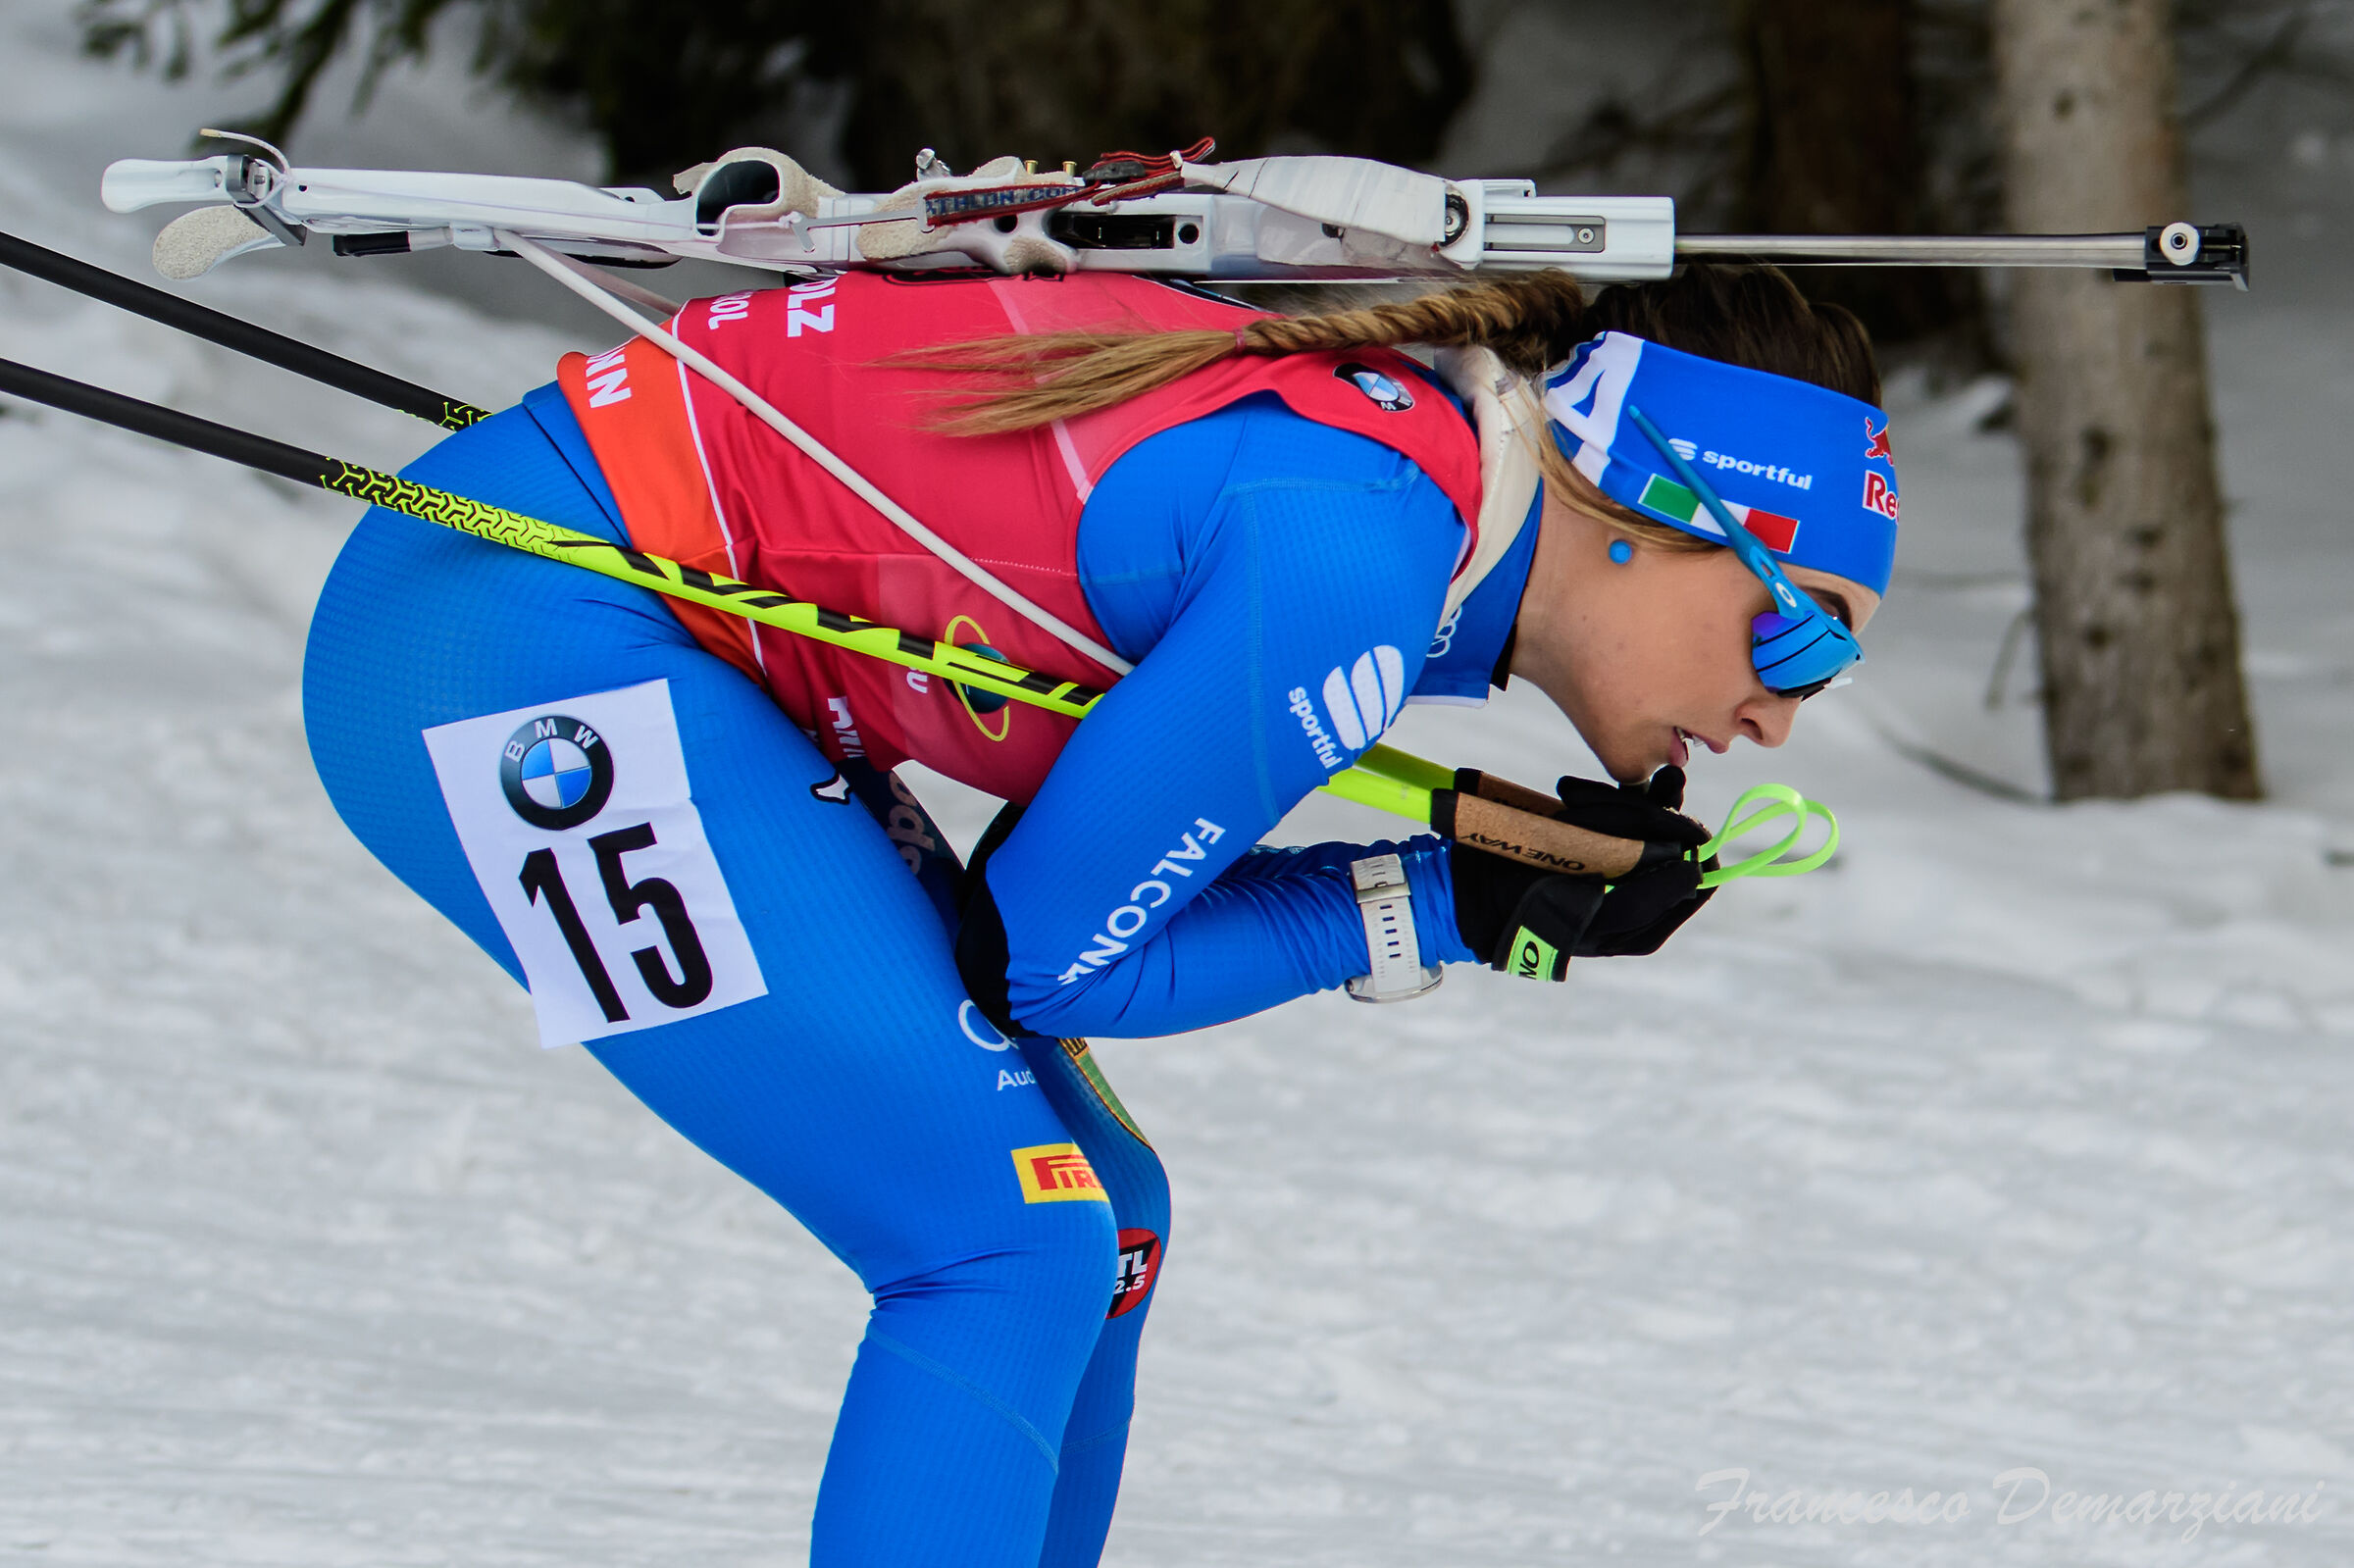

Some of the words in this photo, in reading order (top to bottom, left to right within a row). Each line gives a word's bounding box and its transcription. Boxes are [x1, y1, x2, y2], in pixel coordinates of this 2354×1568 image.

[1702, 448, 1813, 491] sportful
[1863, 469, 1899, 525] Re
[504, 717, 599, 764] BMW
[1288, 685, 1344, 770] sportful
[1460, 833, 1522, 855] WAY
[1523, 848, 1586, 872] ONE
[518, 822, 713, 1024] 15
